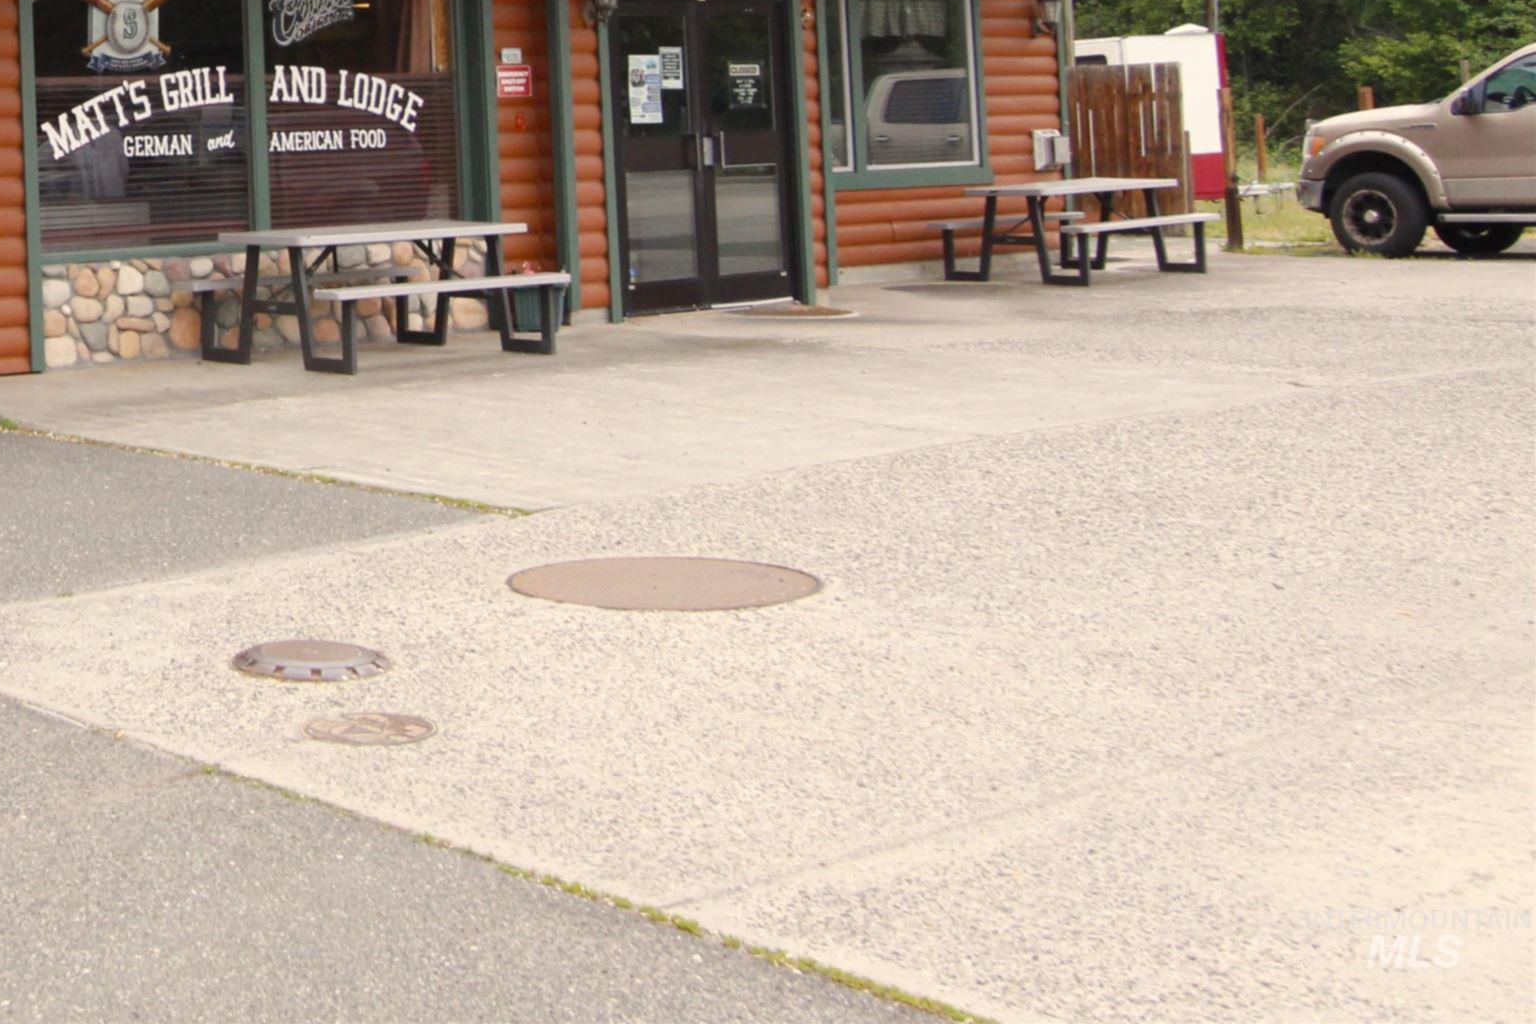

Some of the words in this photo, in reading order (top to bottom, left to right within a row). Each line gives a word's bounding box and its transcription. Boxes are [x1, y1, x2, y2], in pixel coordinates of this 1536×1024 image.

[41, 79, 152, 160] MATT'S
[159, 65, 234, 112] GRILL
[269, 65, 327, 104] AND
[337, 69, 424, 133] LODGE
[123, 133, 193, 157] GERMAN
[206, 129, 235, 151] and
[269, 130, 344, 152] AMERICAN
[350, 128, 386, 149] FOOD
